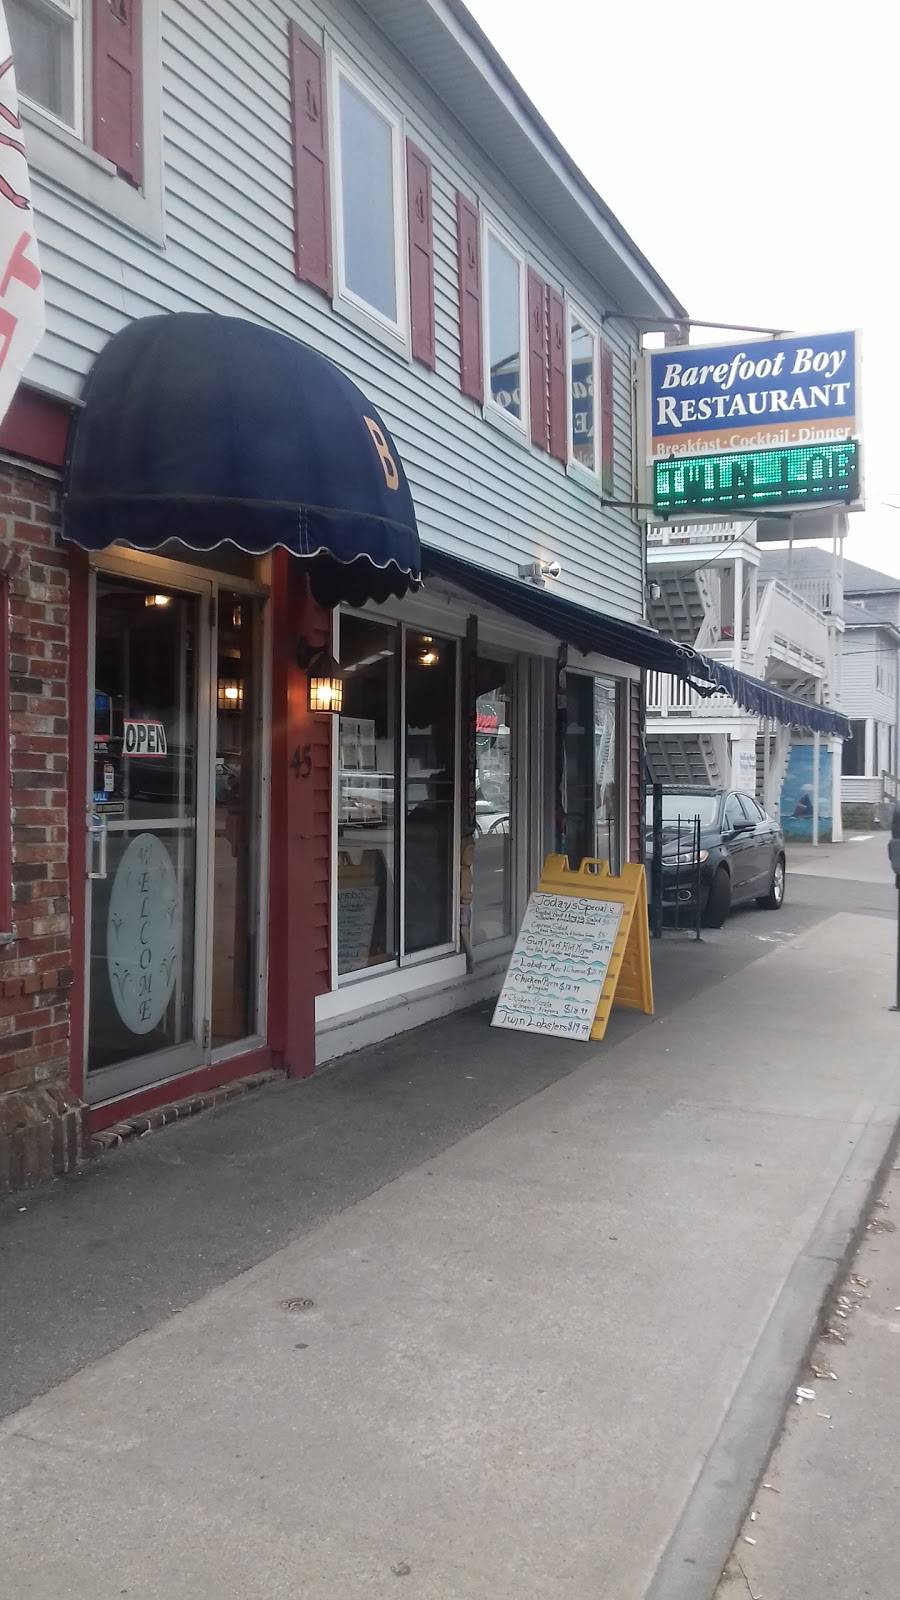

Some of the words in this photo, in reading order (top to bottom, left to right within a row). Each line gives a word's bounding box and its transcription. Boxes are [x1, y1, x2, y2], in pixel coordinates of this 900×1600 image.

[661, 351, 785, 390] Barefoot
[790, 347, 847, 378] Boy
[656, 381, 851, 428] RESTAURANT
[363, 415, 399, 491] B
[656, 436, 721, 456] Breakfast
[729, 429, 790, 449] Cocktail
[799, 426, 851, 442] Dinner
[125, 723, 166, 753] OPEN
[291, 743, 312, 780] 45
[137, 845, 153, 1022] WELCOME
[514, 973, 542, 985] Chicken
[498, 1009, 526, 1026] Twin
[525, 1014, 568, 1031] Lobsters
